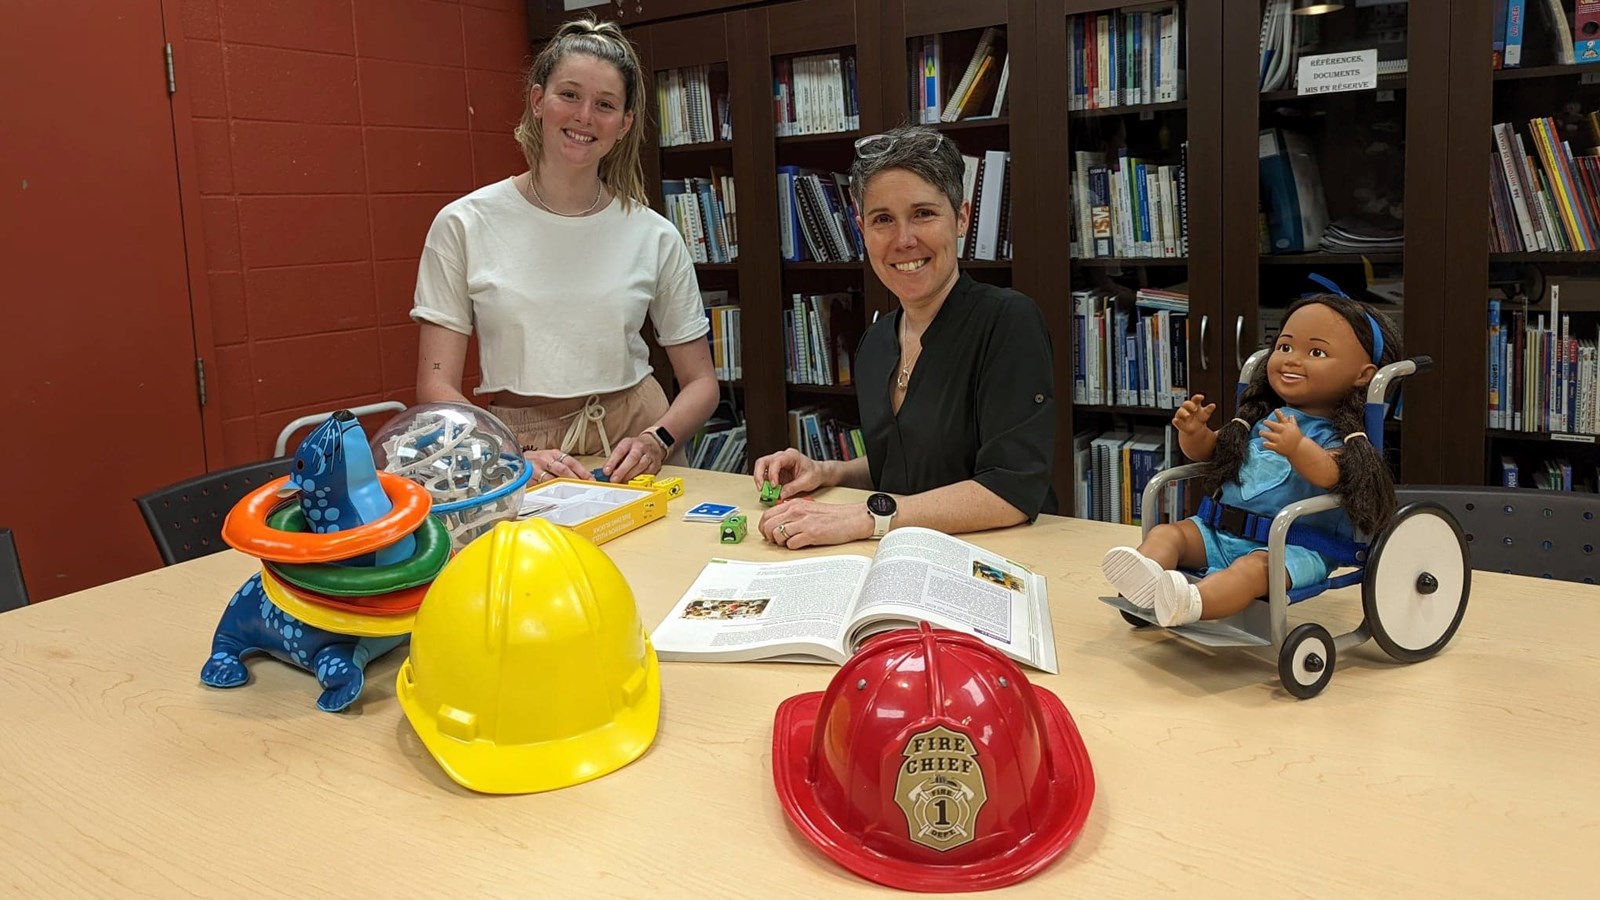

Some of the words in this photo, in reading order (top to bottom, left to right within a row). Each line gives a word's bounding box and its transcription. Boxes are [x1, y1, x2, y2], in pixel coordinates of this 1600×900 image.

[1310, 56, 1364, 67] RÉFÉRENCES,
[1313, 69, 1361, 80] DOCUMENTS
[1305, 86, 1318, 94] MIS
[1320, 84, 1330, 92] EN
[1332, 81, 1369, 91] RÉSERVE
[914, 737, 965, 752] FIRE
[906, 758, 972, 774] CHIEF
[931, 789, 953, 797] FIRE
[934, 799, 950, 826] 1
